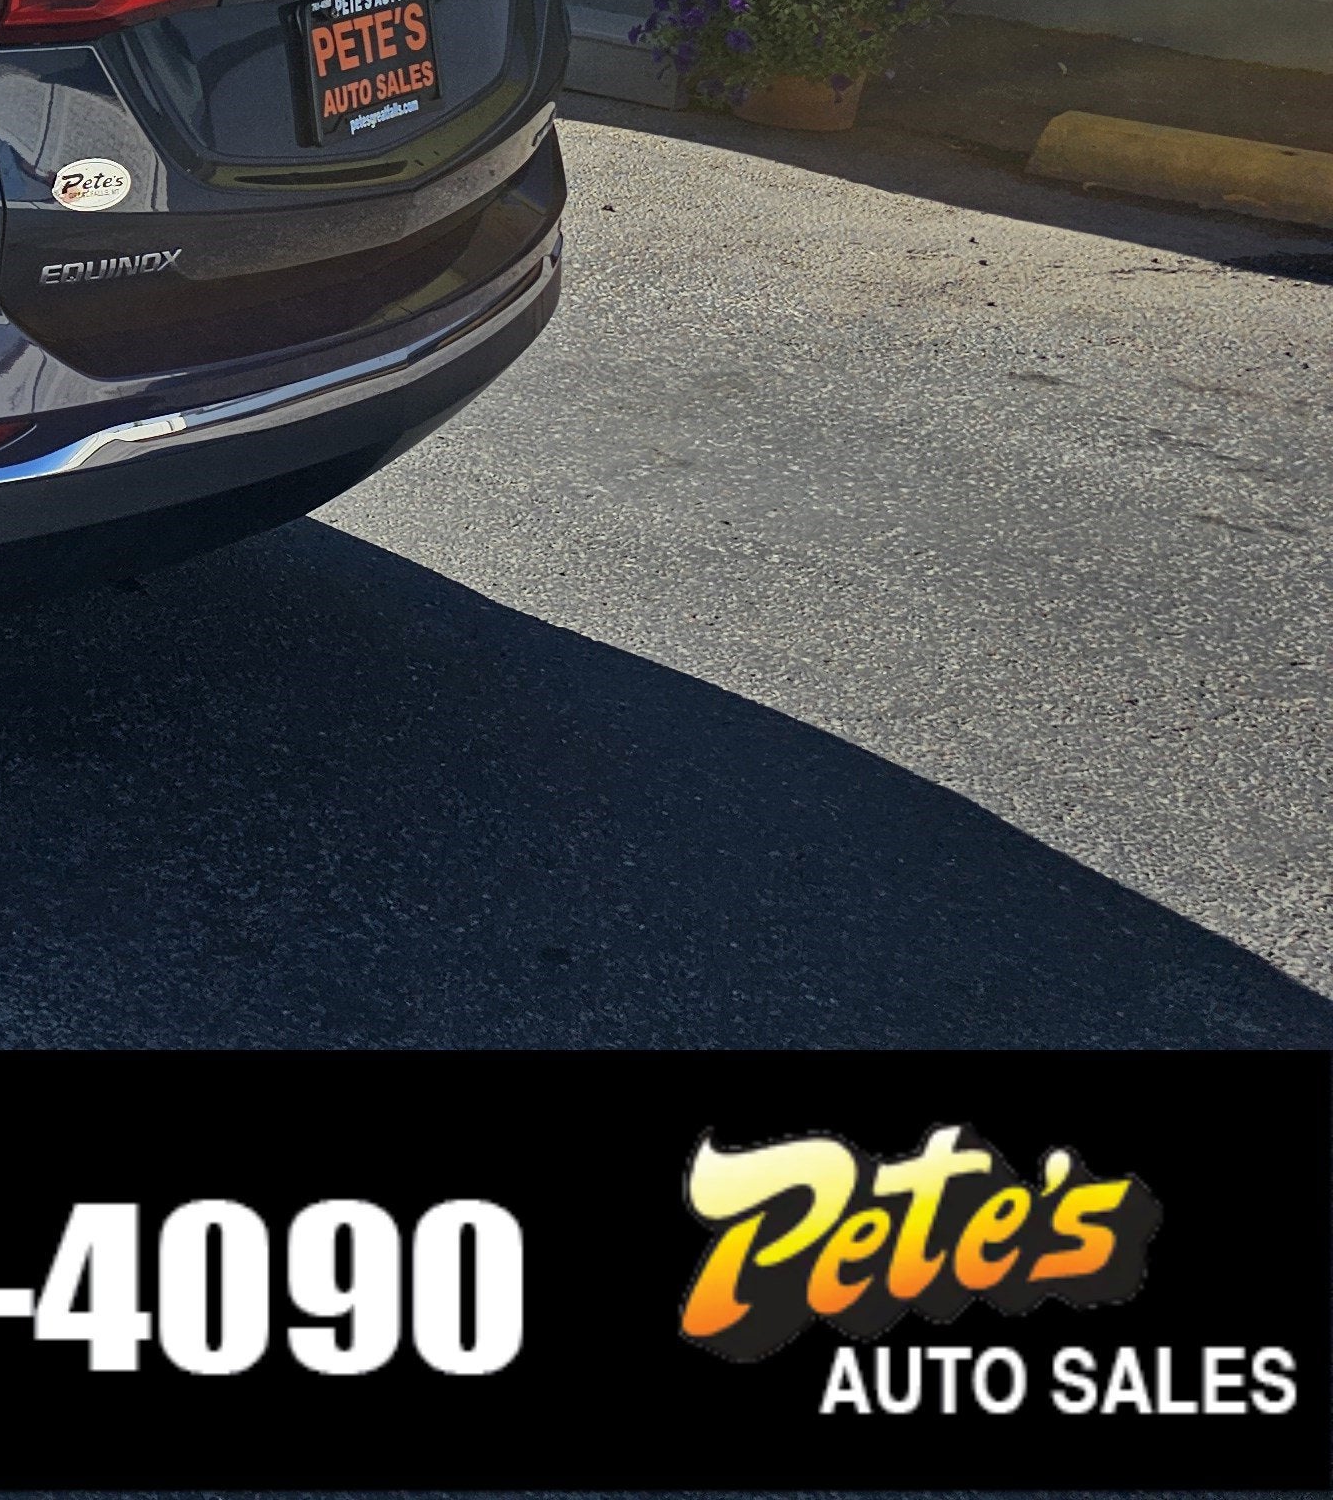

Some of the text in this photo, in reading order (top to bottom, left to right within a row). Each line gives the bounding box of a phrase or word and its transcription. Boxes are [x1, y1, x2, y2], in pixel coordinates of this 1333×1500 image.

[311, 2, 428, 77] PETE'S
[323, 60, 435, 118] AUTO SALES
[61, 172, 124, 195] Pete's
[39, 248, 183, 285] EQUINOX
